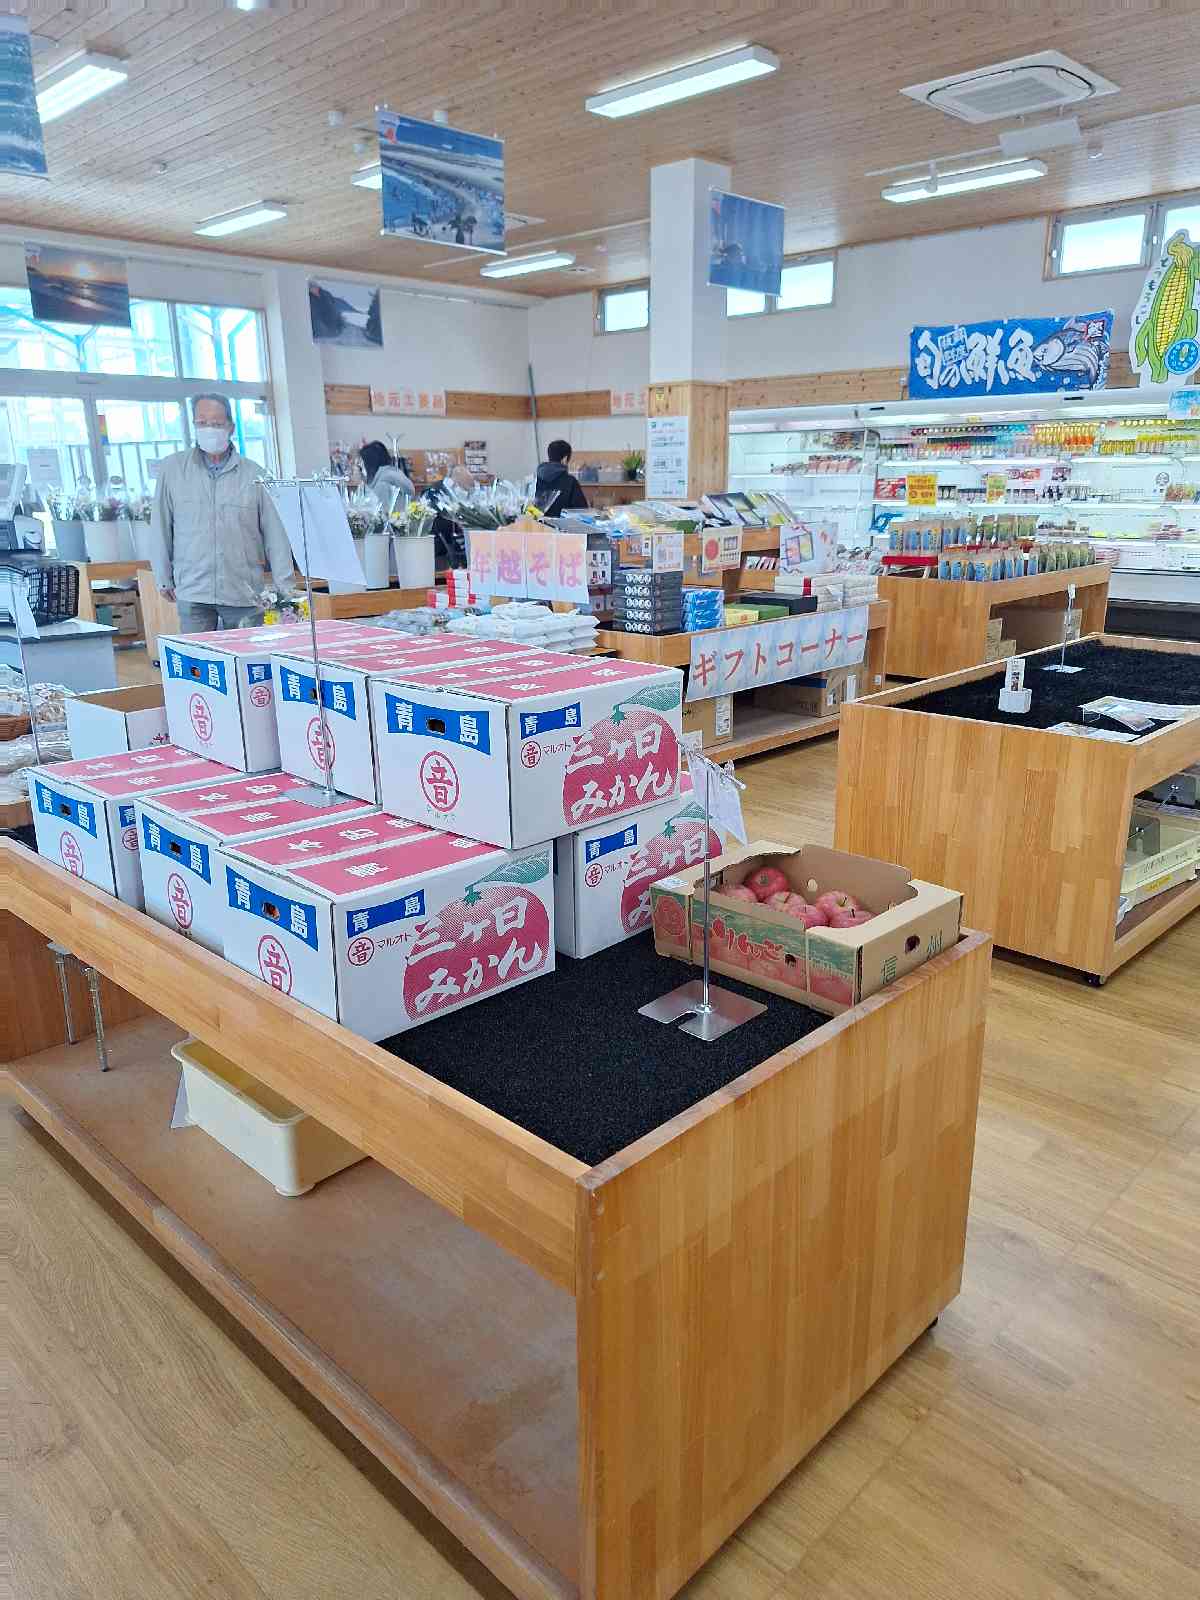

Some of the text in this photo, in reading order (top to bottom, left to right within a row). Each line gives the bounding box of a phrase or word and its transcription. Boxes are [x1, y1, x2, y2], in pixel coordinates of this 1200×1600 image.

[693, 629, 864, 687] ギフトコーナー
[394, 701, 479, 746] 青島
[524, 707, 578, 735] 青島
[523, 742, 540, 765] 音
[427, 758, 454, 806] 音
[570, 761, 672, 820] みかん
[590, 829, 635, 859] 青島
[234, 875, 309, 938] 青島
[351, 893, 423, 933] 青島
[351, 938, 373, 966] 音
[376, 931, 413, 950] マルオト
[415, 940, 542, 1006] みかん
